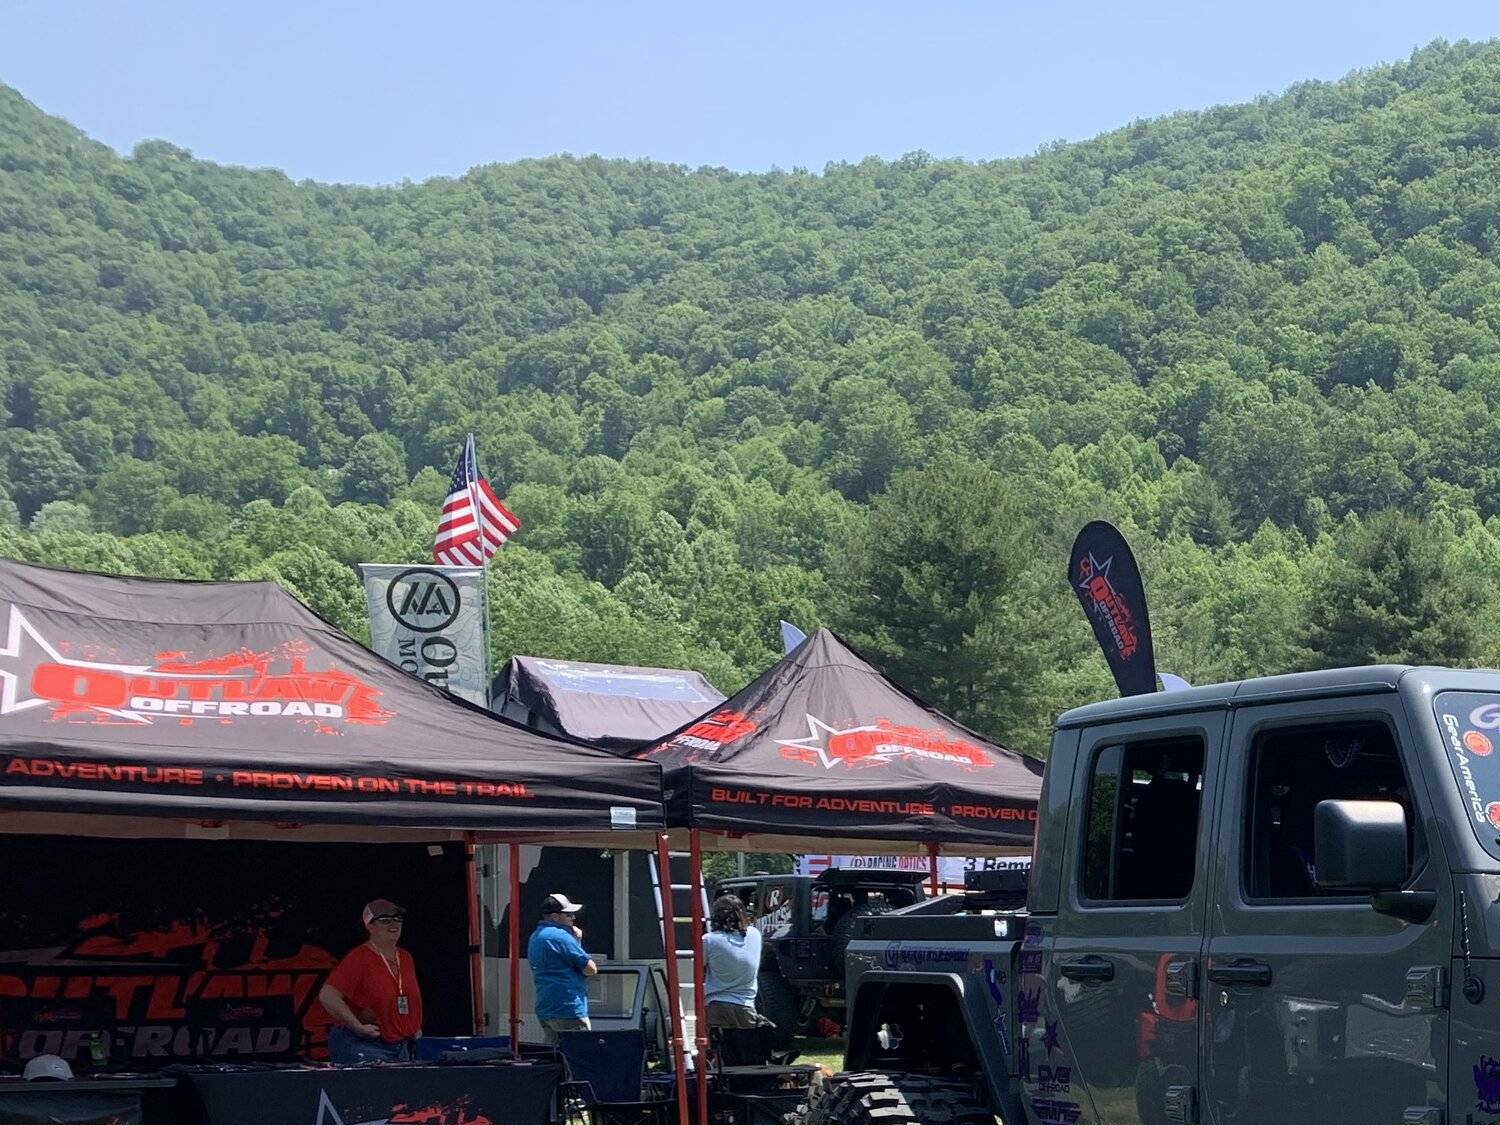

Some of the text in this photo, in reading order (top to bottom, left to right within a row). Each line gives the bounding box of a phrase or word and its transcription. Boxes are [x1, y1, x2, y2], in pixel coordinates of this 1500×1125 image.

[31, 663, 356, 706] OUTLAW
[130, 696, 343, 719] OFFROAD
[875, 744, 973, 764] OFFROAD
[6, 758, 536, 798] ADVENTURE PROVEN ON THE TRAIL
[711, 788, 769, 806] BUILT
[771, 794, 814, 809] FOR
[815, 798, 935, 816] ADVENTURE
[951, 804, 1024, 821] PROVEN
